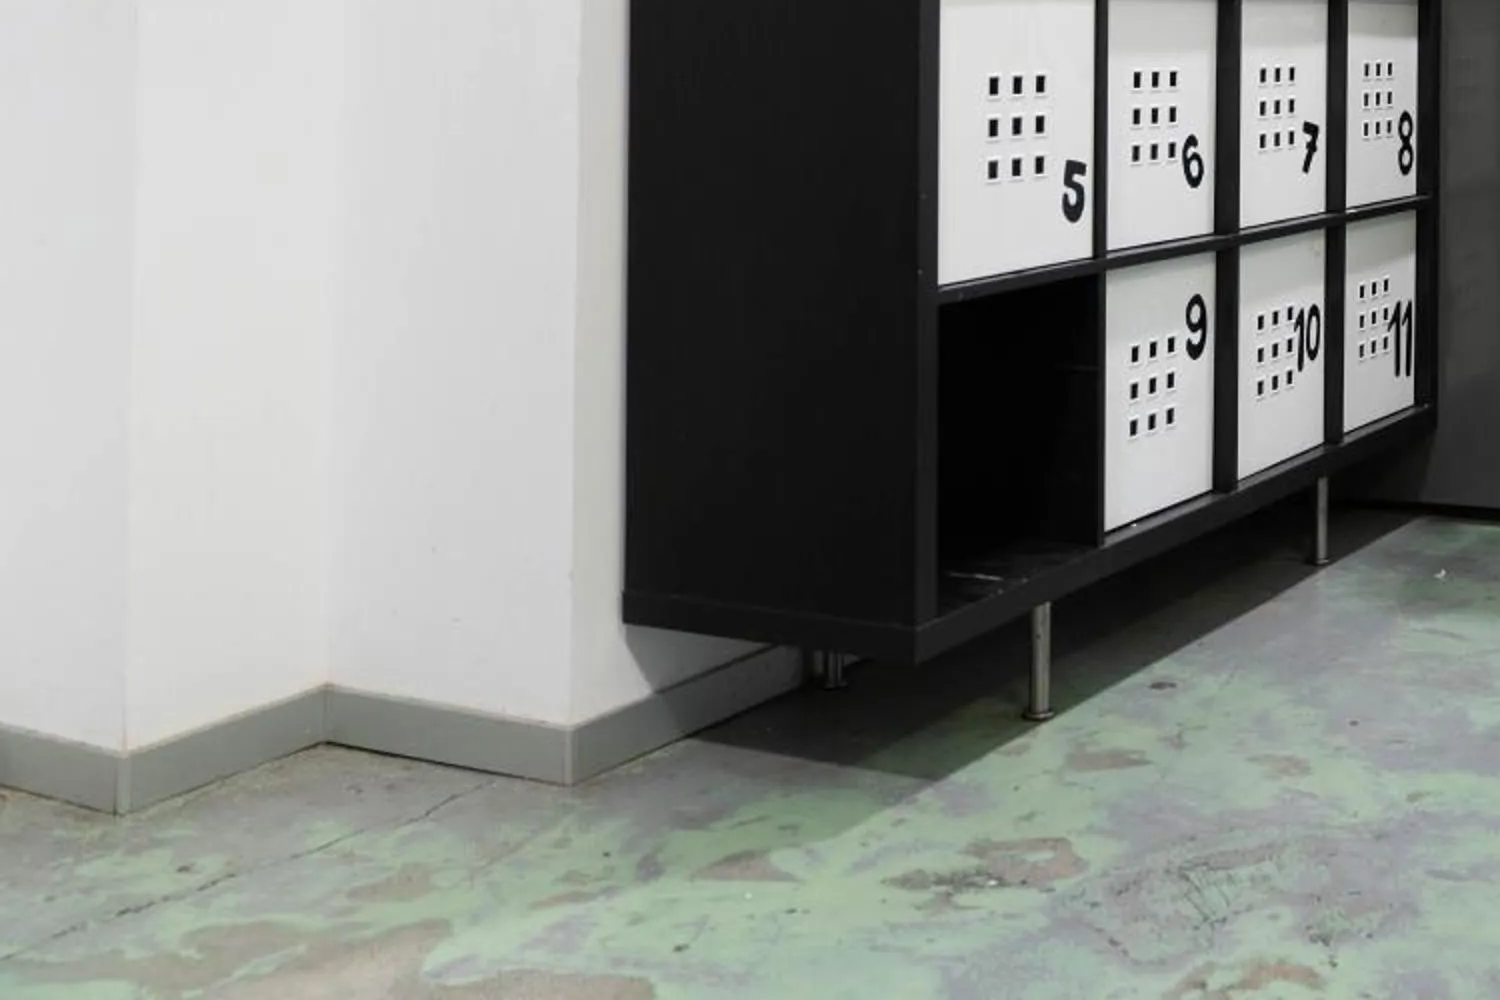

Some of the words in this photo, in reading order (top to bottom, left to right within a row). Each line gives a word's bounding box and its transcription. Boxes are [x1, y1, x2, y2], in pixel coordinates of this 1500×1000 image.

[1181, 134, 1205, 189] 6
[1302, 121, 1320, 174] 7
[1397, 110, 1414, 176] 8
[1062, 159, 1087, 223] 5
[1185, 293, 1208, 361] 9
[1293, 304, 1321, 372] 10
[1387, 300, 1413, 378] 11
